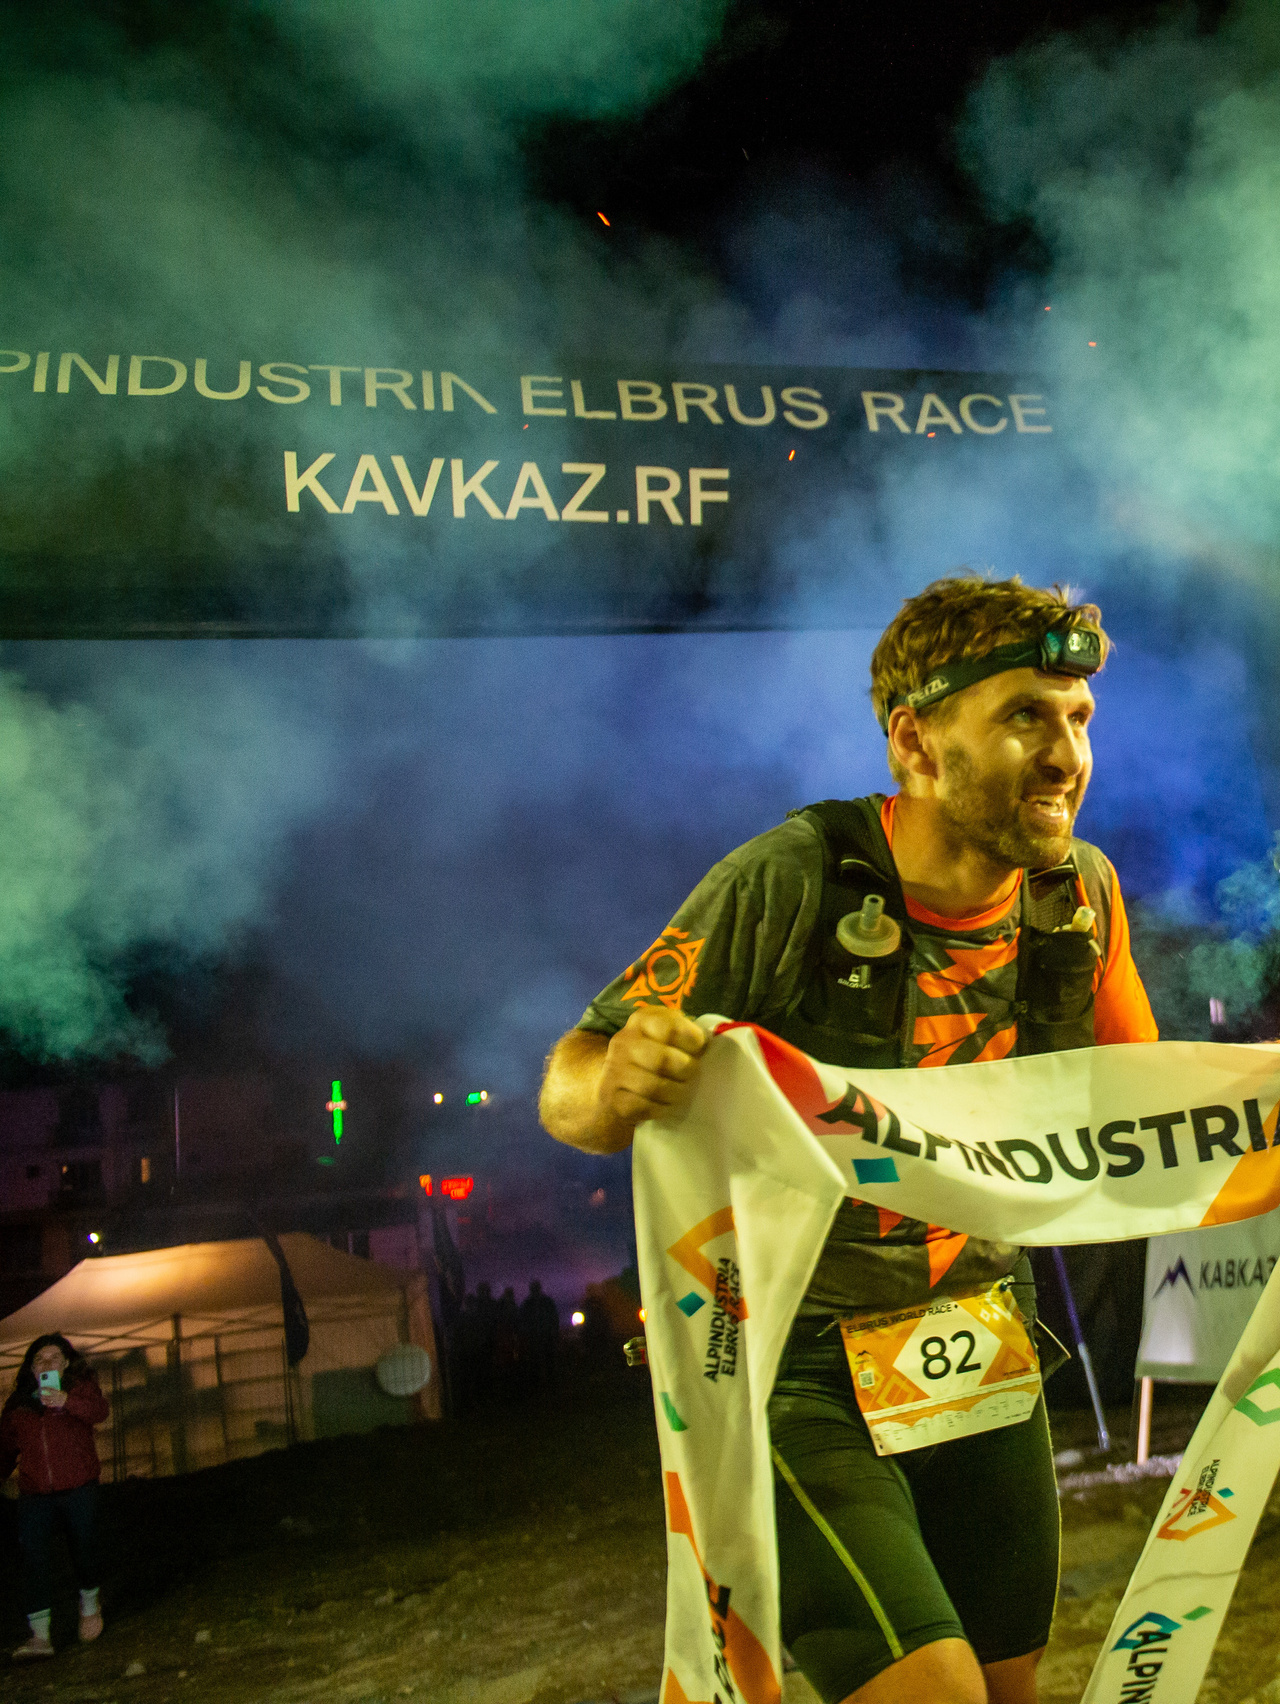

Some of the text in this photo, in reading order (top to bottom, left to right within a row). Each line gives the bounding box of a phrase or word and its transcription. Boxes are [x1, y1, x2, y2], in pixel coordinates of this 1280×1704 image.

[520, 375, 829, 430] ELBRUS
[861, 390, 1053, 435] RACE
[283, 451, 730, 526] KAVKAZ.RF
[703, 1257, 731, 1384] ALPINDUSTRIA
[720, 1312, 739, 1377] ELBRUS
[846, 1303, 953, 1334] ELBRUS WORLD RACE
[920, 1330, 982, 1380] 82
[1118, 1630, 1172, 1704] ALPIN
